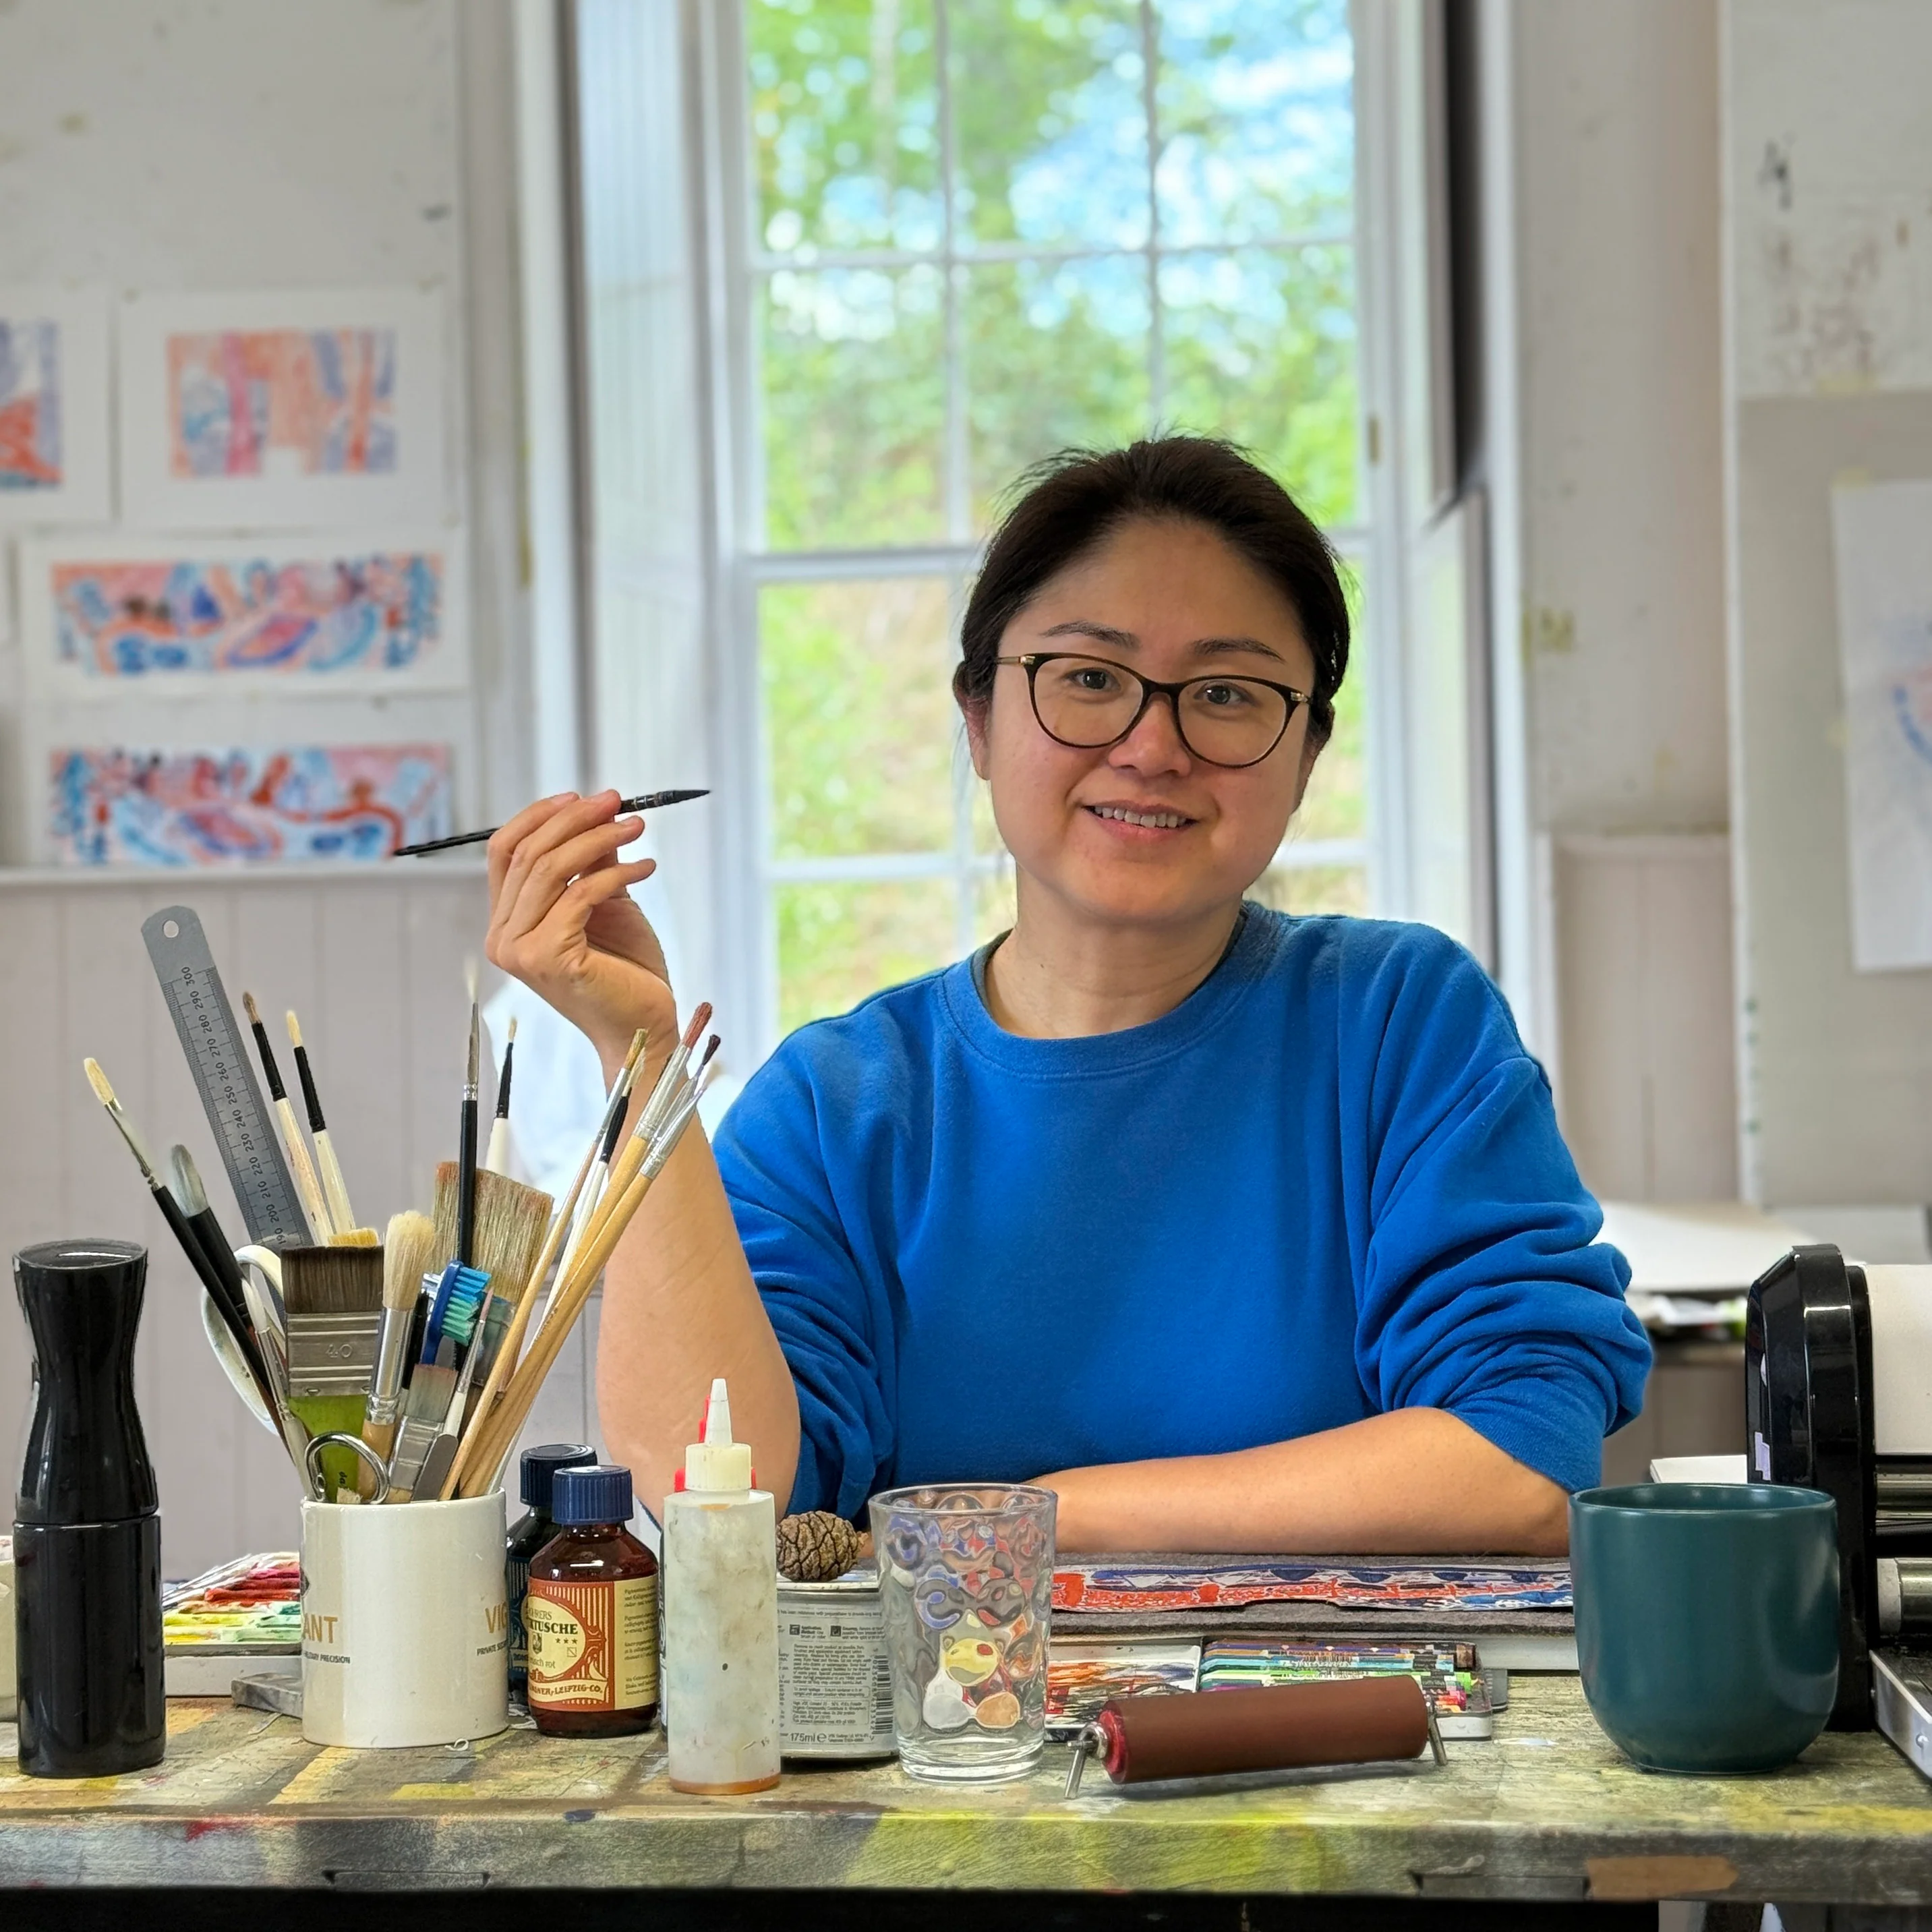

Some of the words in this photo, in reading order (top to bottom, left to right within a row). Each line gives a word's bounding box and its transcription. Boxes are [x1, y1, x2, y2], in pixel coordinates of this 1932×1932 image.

[181, 966, 195, 987] 300
[189, 991, 204, 1010] 290
[198, 1014, 212, 1034] 280
[206, 1038, 221, 1057] 270
[215, 1062, 229, 1081] 260
[224, 1086, 237, 1105] 250
[232, 1109, 246, 1129] 240
[241, 1133, 254, 1152] 230
[249, 1157, 263, 1176] 220
[258, 1181, 271, 1199] 210
[266, 1204, 279, 1223] 200
[274, 1227, 287, 1245] 190
[325, 1343, 353, 1358] 40
[790, 1732, 815, 1743] 175ml
